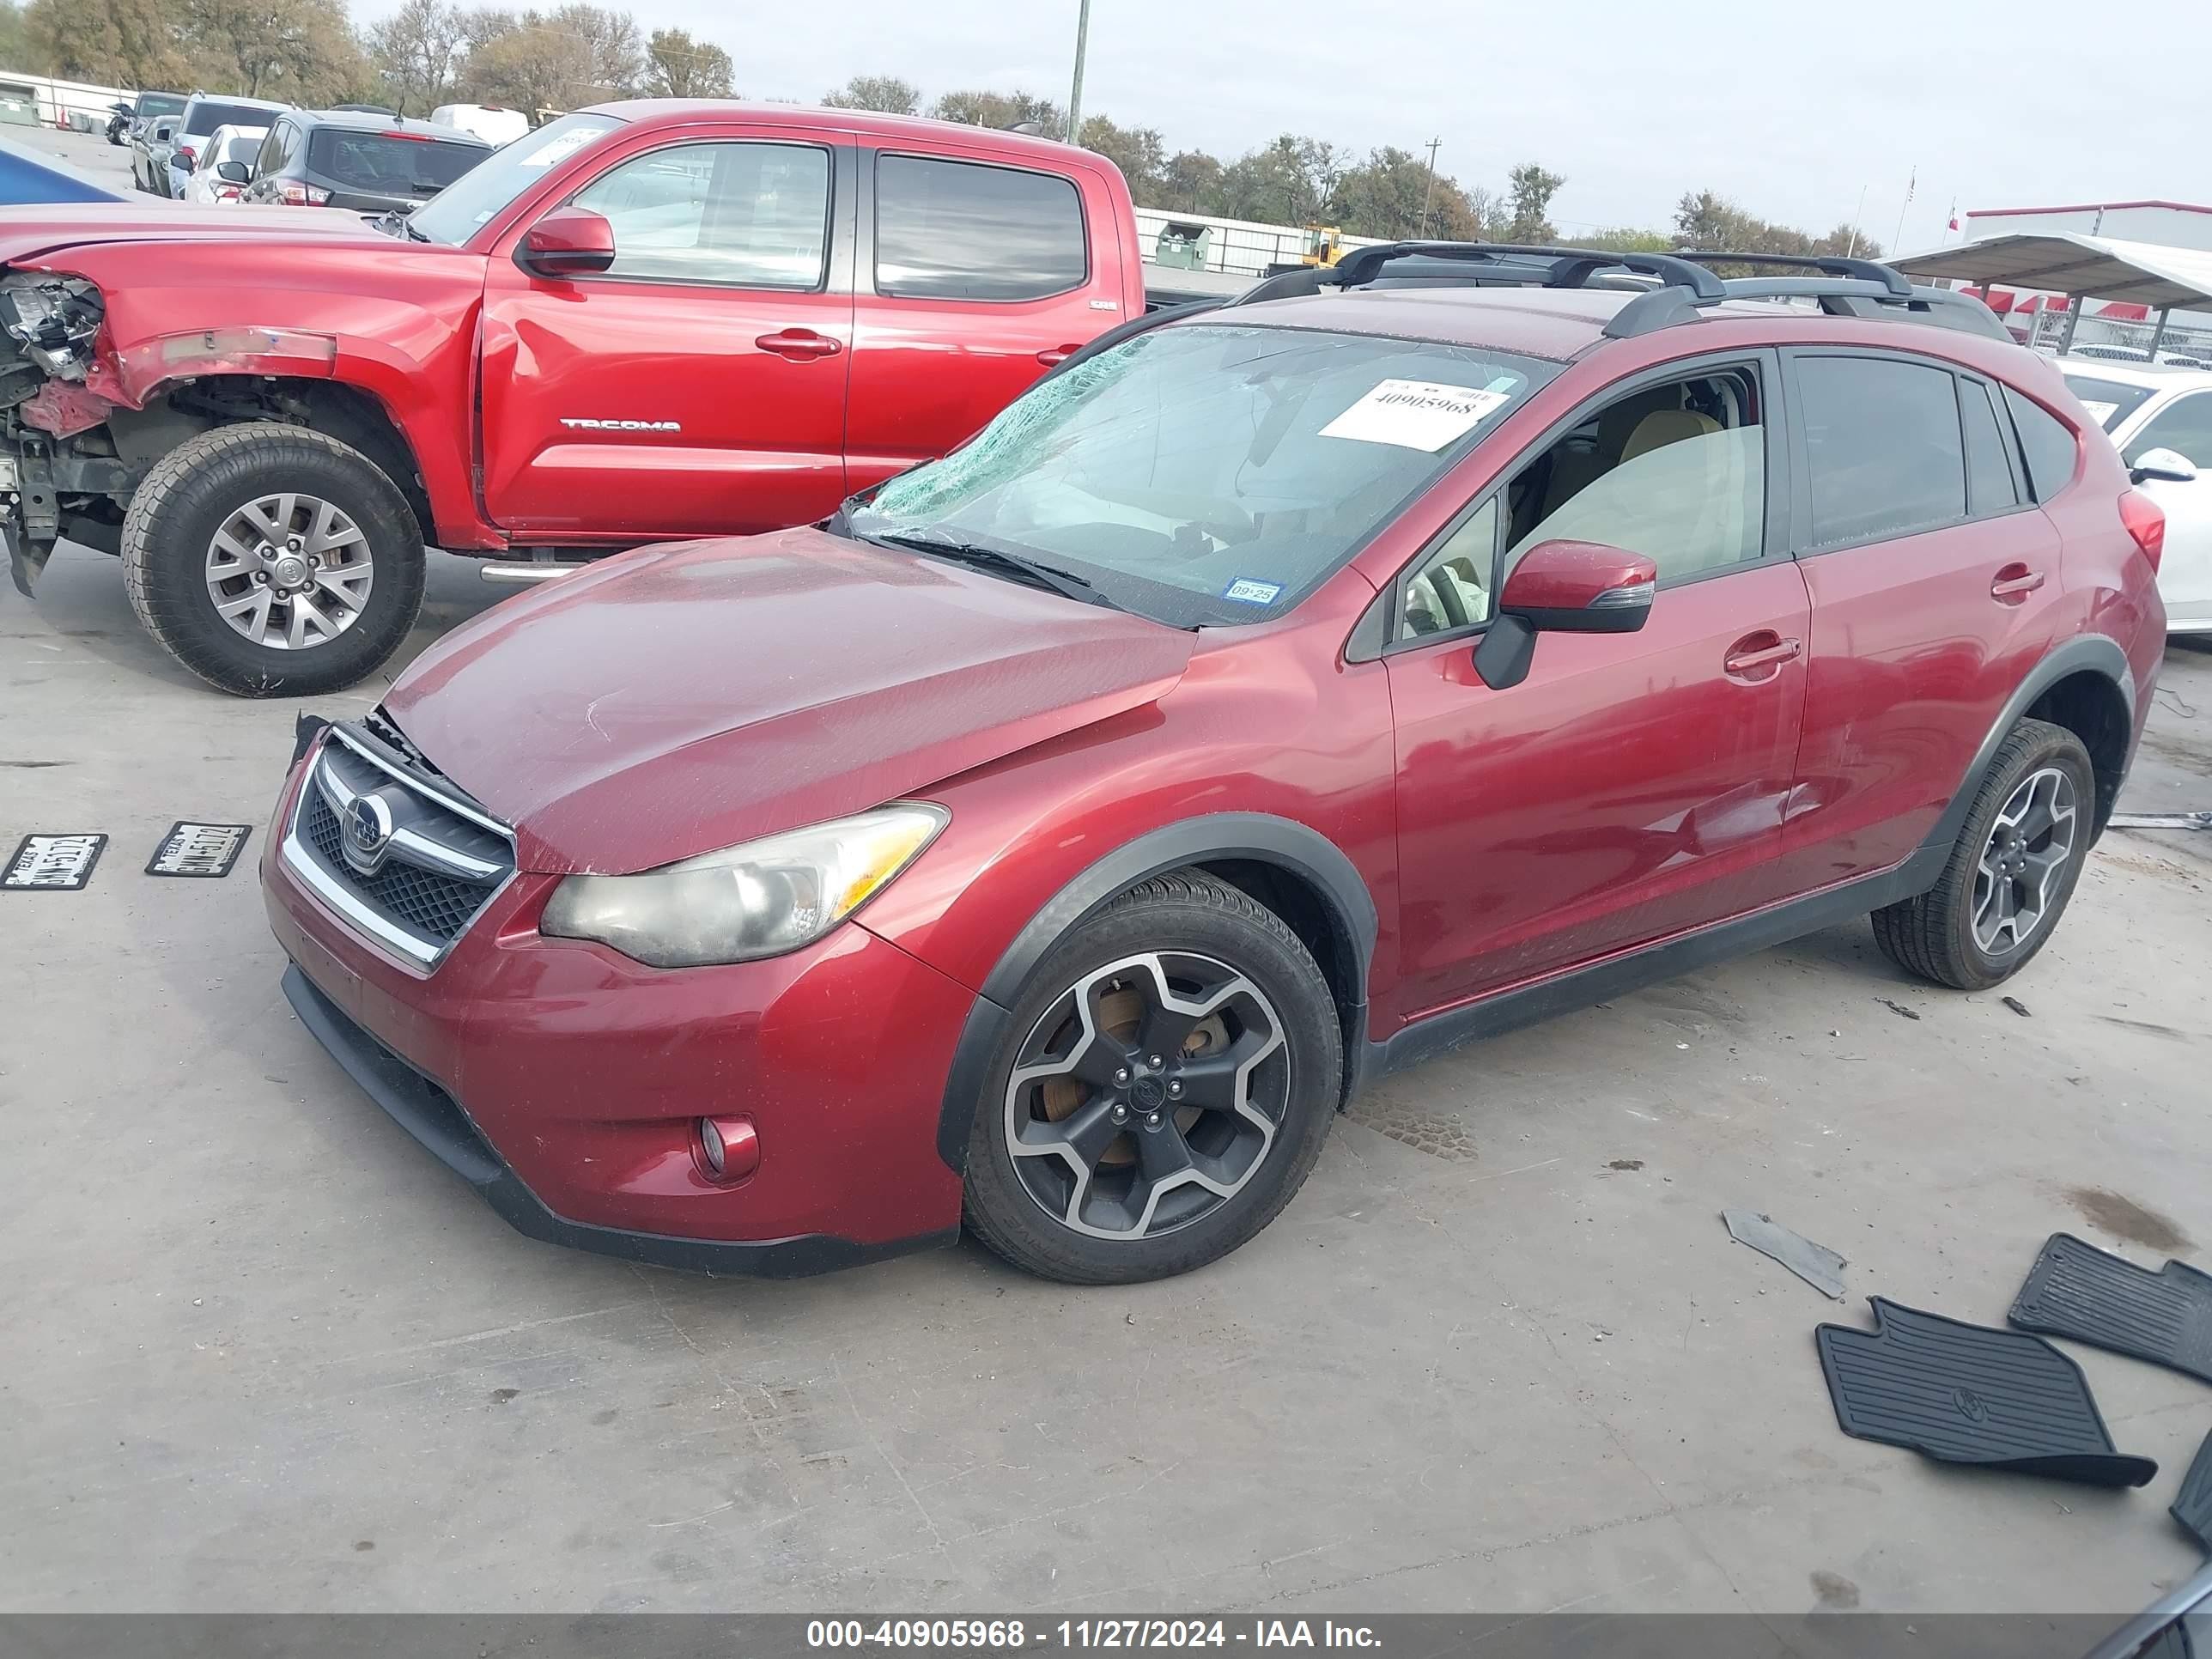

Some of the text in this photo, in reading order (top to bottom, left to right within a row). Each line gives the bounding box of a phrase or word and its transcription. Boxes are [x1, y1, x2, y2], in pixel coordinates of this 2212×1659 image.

[1375, 392, 1477, 415] 40905968
[559, 417, 682, 434] TACOMA
[161, 838, 185, 858] TEXAS
[15, 851, 39, 872] TEXAS
